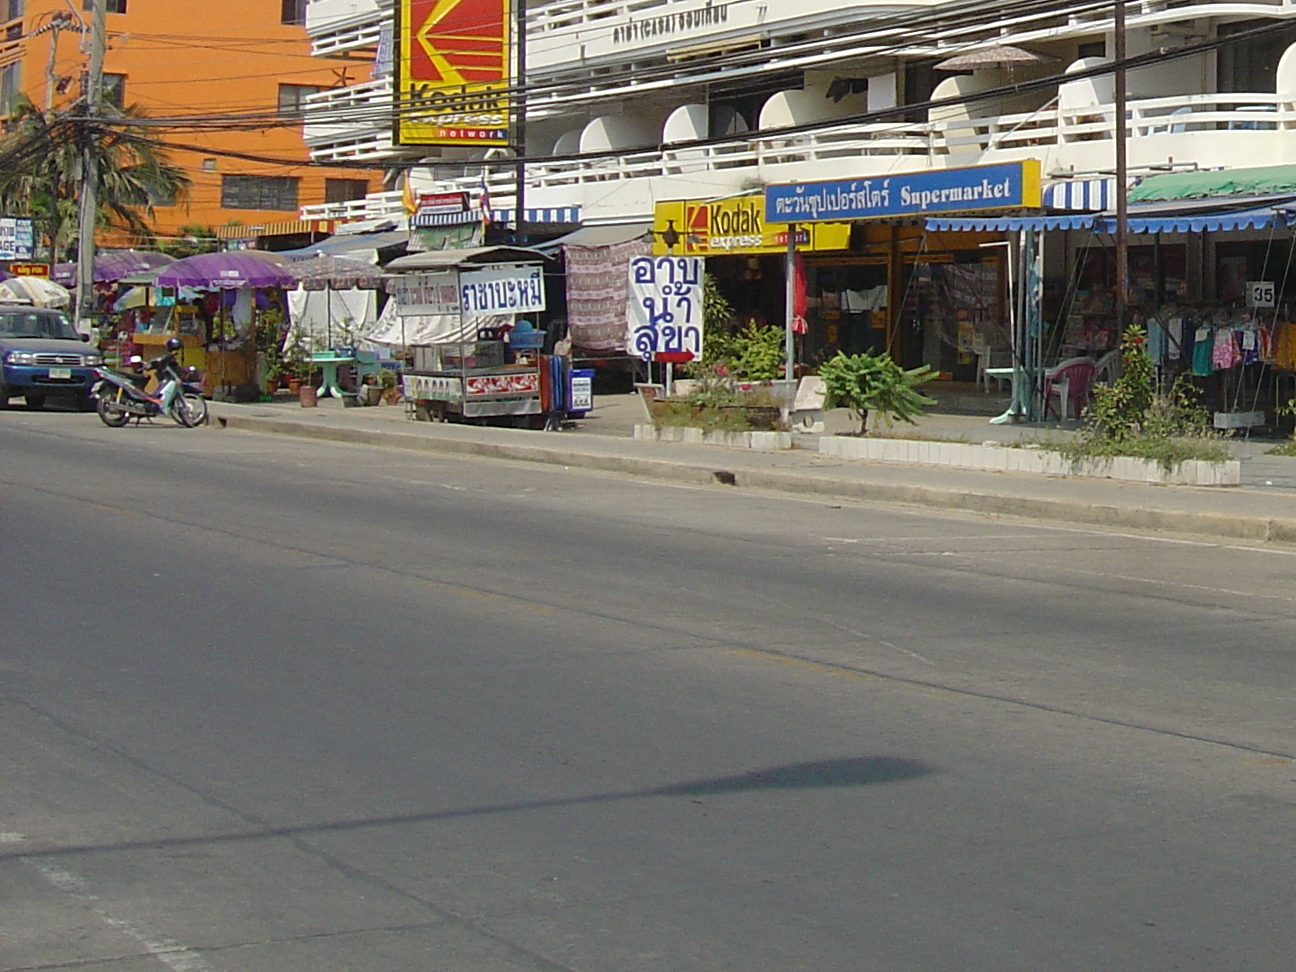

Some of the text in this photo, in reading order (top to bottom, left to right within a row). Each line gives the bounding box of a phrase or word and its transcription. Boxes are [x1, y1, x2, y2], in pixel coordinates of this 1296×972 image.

[439, 129, 504, 139] network
[900, 177, 1011, 209] Supermarket
[710, 202, 761, 234] Kodak
[709, 234, 763, 251] express
[631, 257, 698, 285] อาบ
[642, 280, 692, 326] น้ำ
[1253, 287, 1273, 302] 35
[634, 325, 700, 362] สุขา
